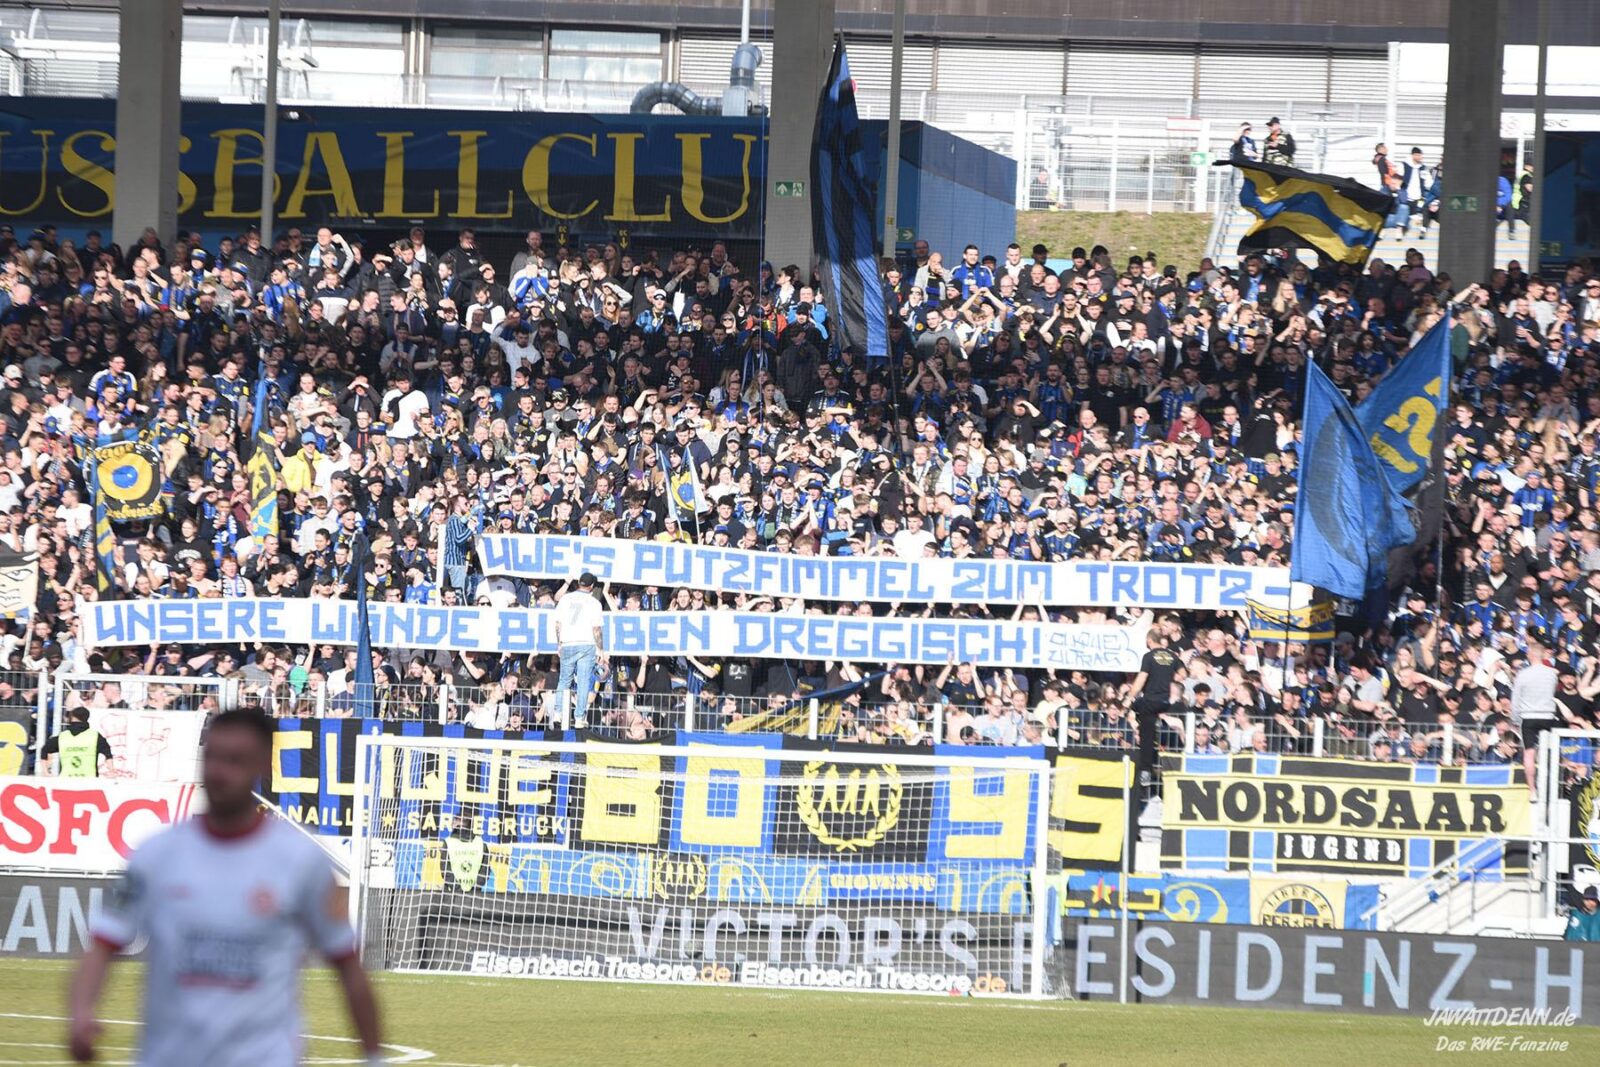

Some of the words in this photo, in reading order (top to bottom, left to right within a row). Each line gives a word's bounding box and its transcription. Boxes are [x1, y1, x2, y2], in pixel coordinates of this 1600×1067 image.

[481, 537, 616, 578] UWE'S
[633, 544, 935, 599] PUTZFIMMEL
[952, 561, 1052, 600] ZUM
[95, 600, 286, 642] UNSERE
[498, 608, 711, 652] BLIBEN
[733, 615, 1041, 666] DREGGISCH!
[407, 811, 565, 836] SAREBRUCK
[1176, 780, 1508, 834] NORDSAAR
[1282, 833, 1402, 863] JUGEND
[626, 905, 979, 970] VICTOR'S
[470, 950, 600, 978] Eisenbach
[741, 961, 873, 988] Eisenbach
